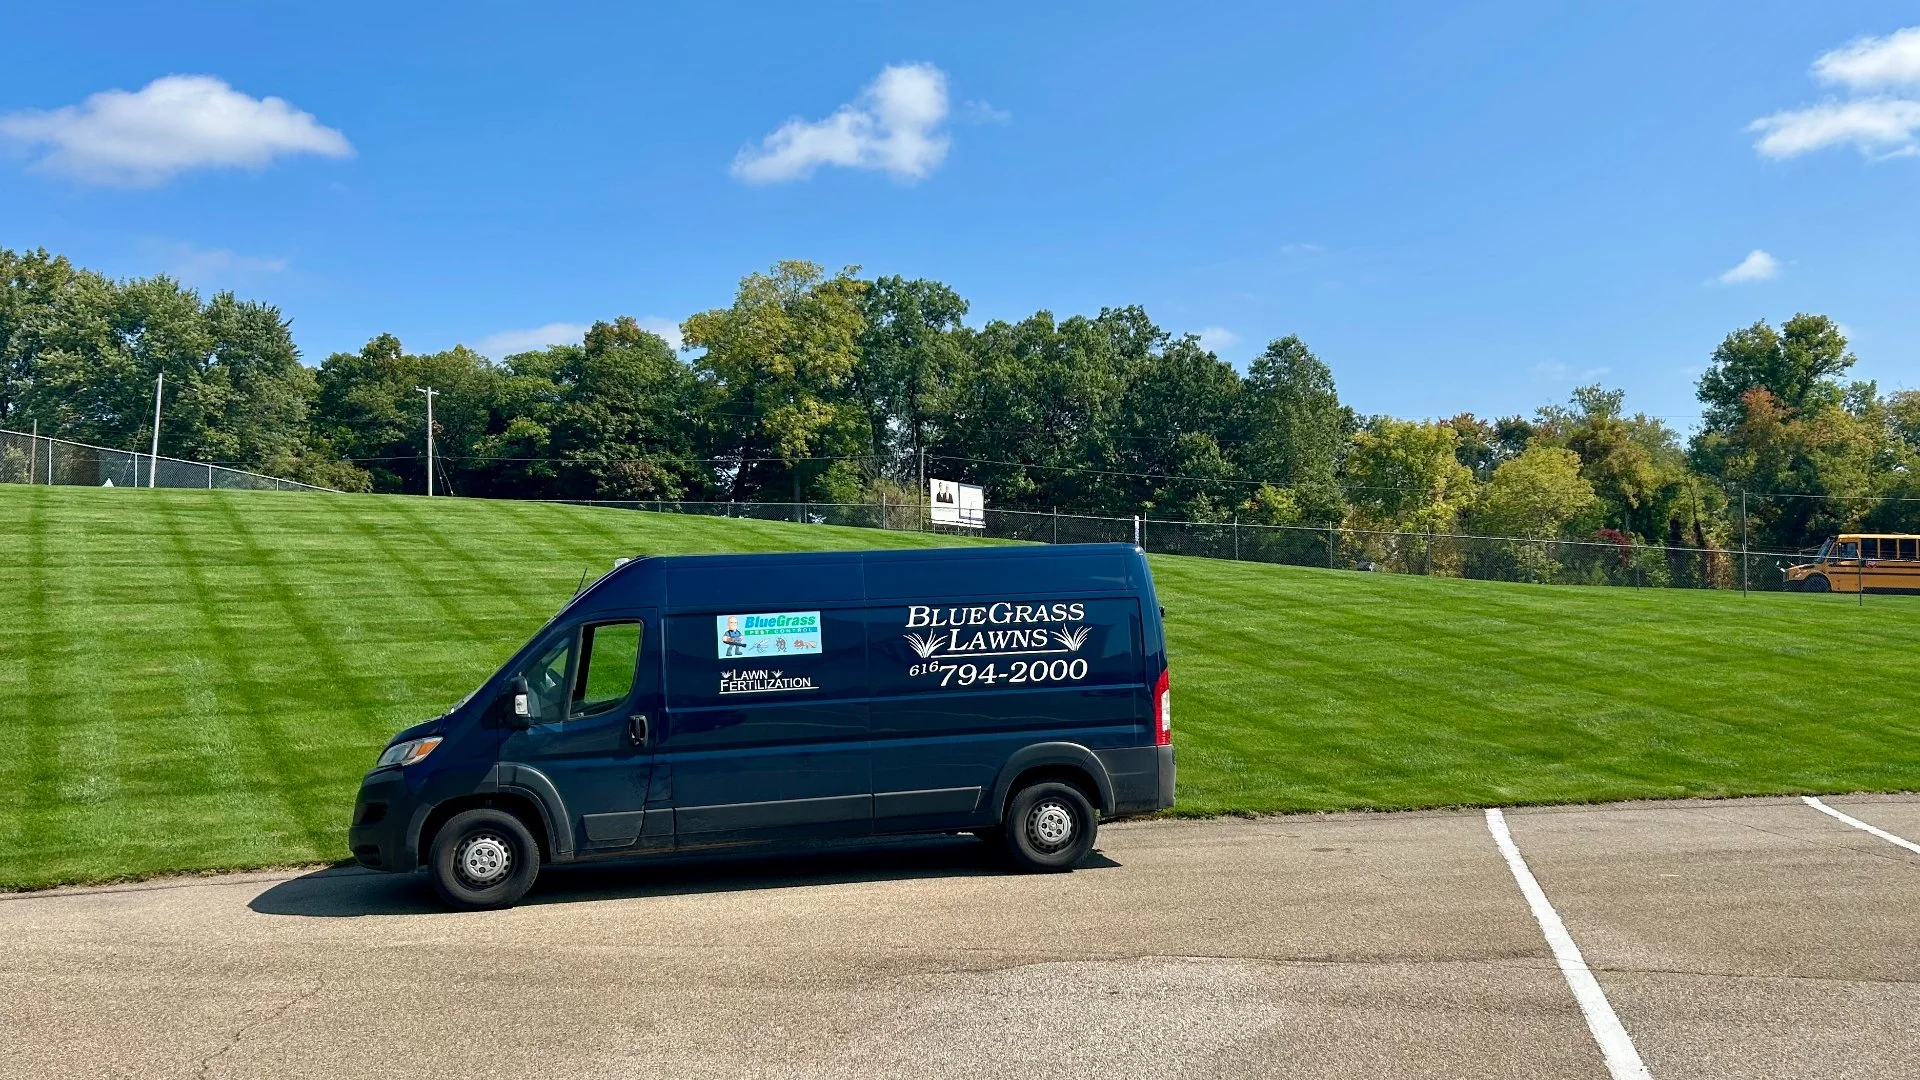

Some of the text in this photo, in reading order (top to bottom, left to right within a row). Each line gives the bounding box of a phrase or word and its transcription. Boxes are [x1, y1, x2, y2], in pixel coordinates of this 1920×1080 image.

[745, 614, 816, 628] BlueGrass
[947, 628, 1048, 651] LAWNS
[733, 669, 768, 681] LAWN
[909, 658, 1088, 687] 616 794-2000
[720, 677, 811, 691] FERTILIZATION
